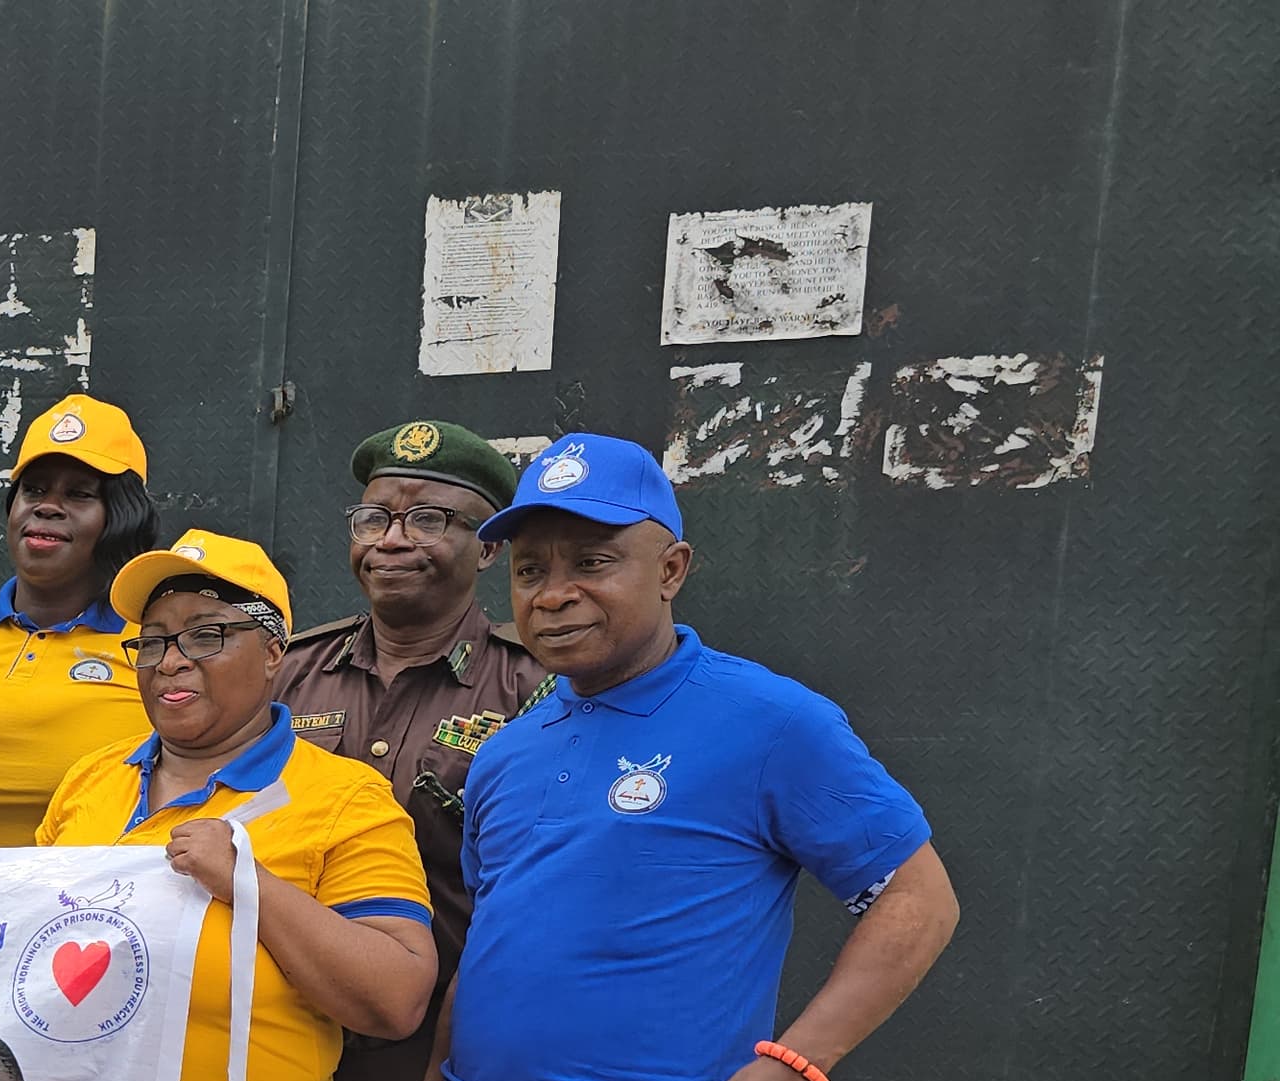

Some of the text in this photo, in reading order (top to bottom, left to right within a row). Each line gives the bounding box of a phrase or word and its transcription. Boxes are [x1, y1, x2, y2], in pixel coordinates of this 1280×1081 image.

[64, 912, 105, 927] PRISONS
[40, 921, 62, 943] STAR
[114, 976, 144, 1022] OUTREACH
[98, 1018, 114, 1032] UK
